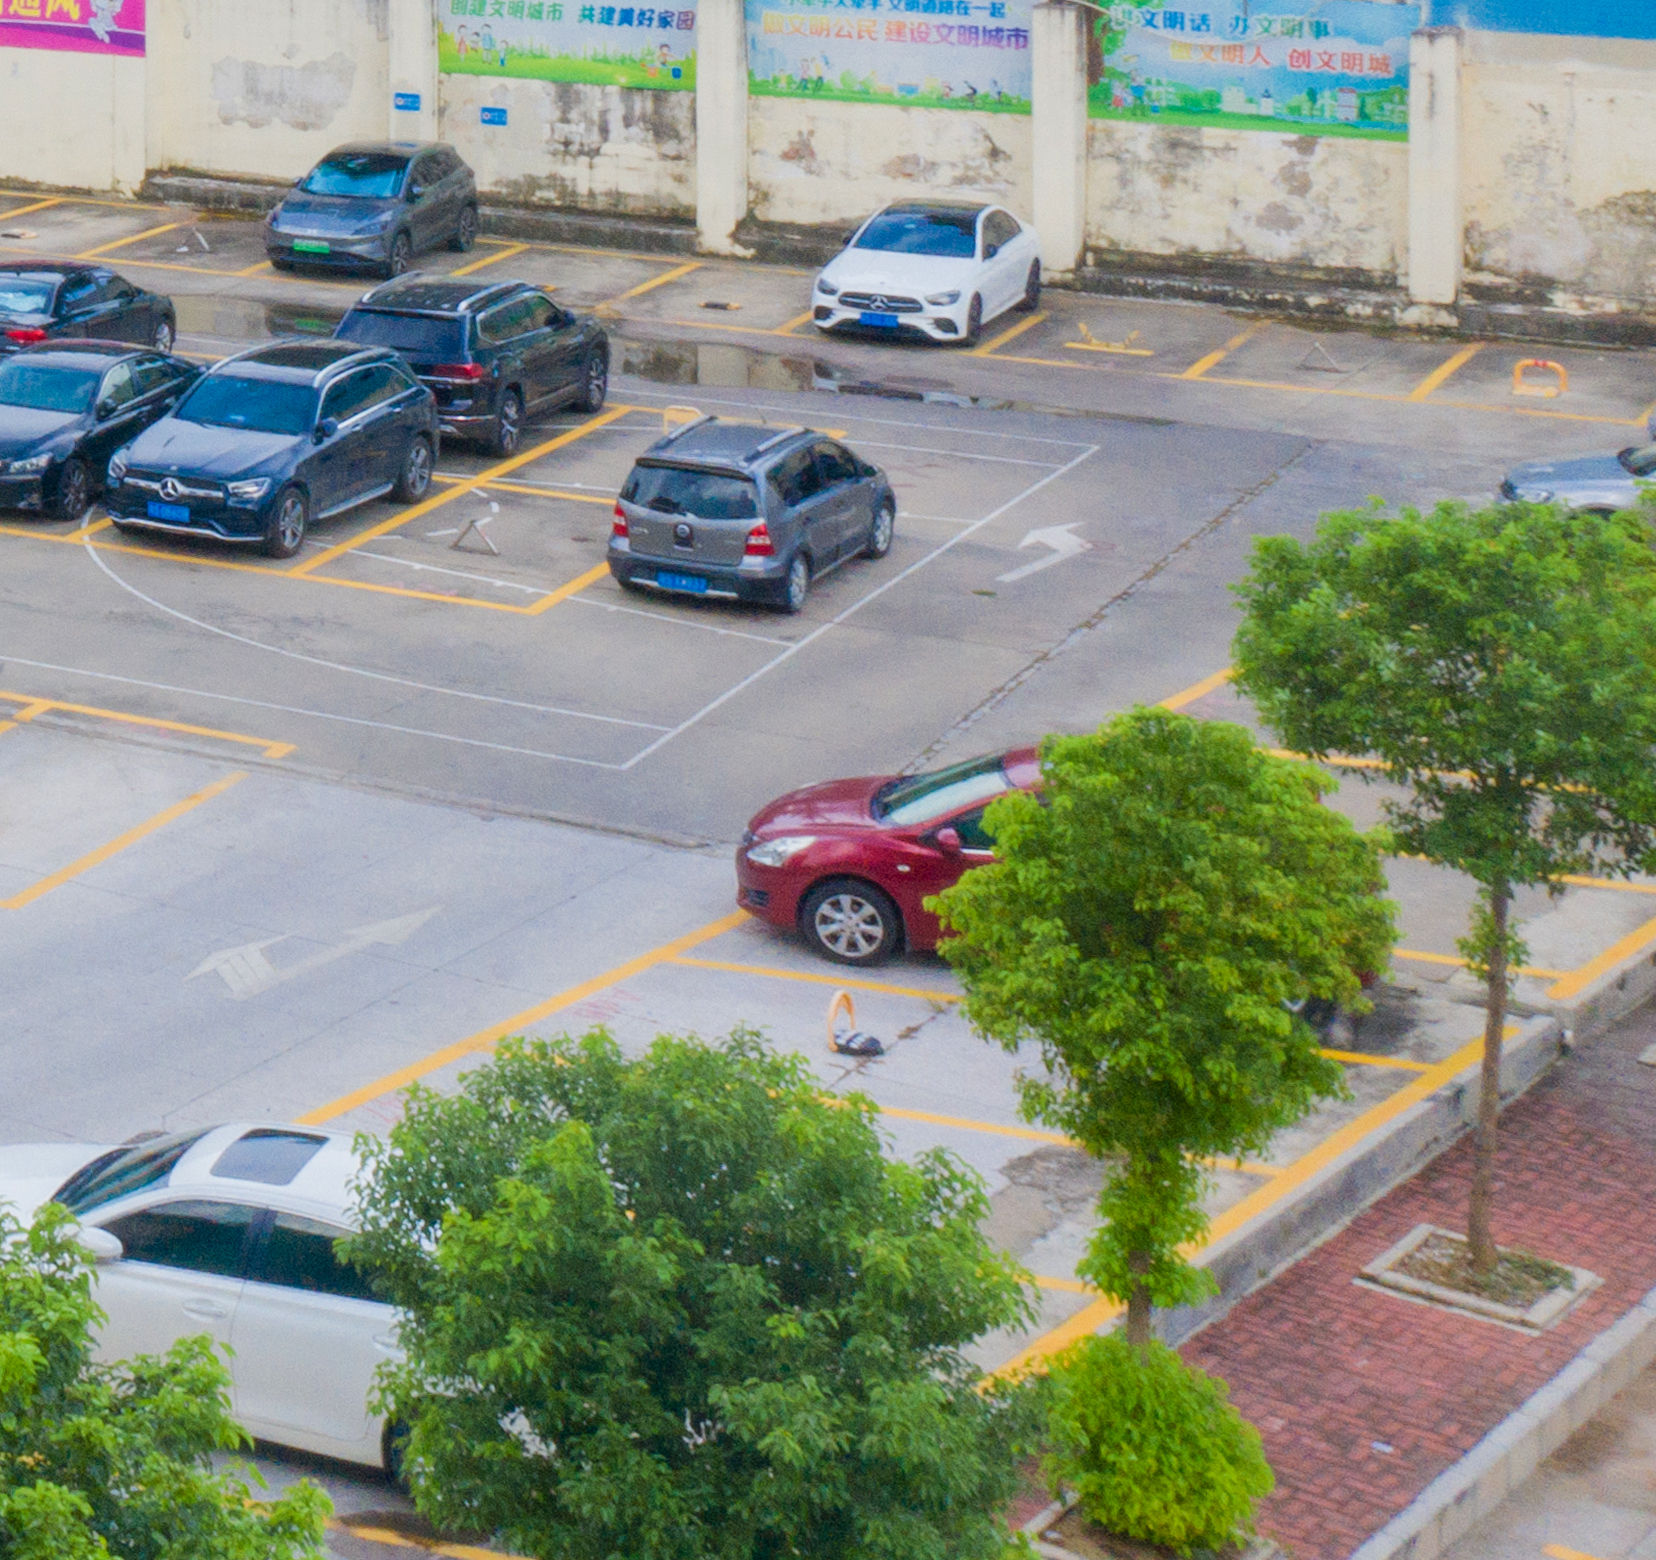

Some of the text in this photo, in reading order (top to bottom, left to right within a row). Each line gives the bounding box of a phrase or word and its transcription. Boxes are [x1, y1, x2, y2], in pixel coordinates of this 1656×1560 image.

[578, 5, 696, 31] 共建美好家园
[885, 19, 1030, 51] 建设文明城市
[1288, 47, 1393, 75] 创文明城
